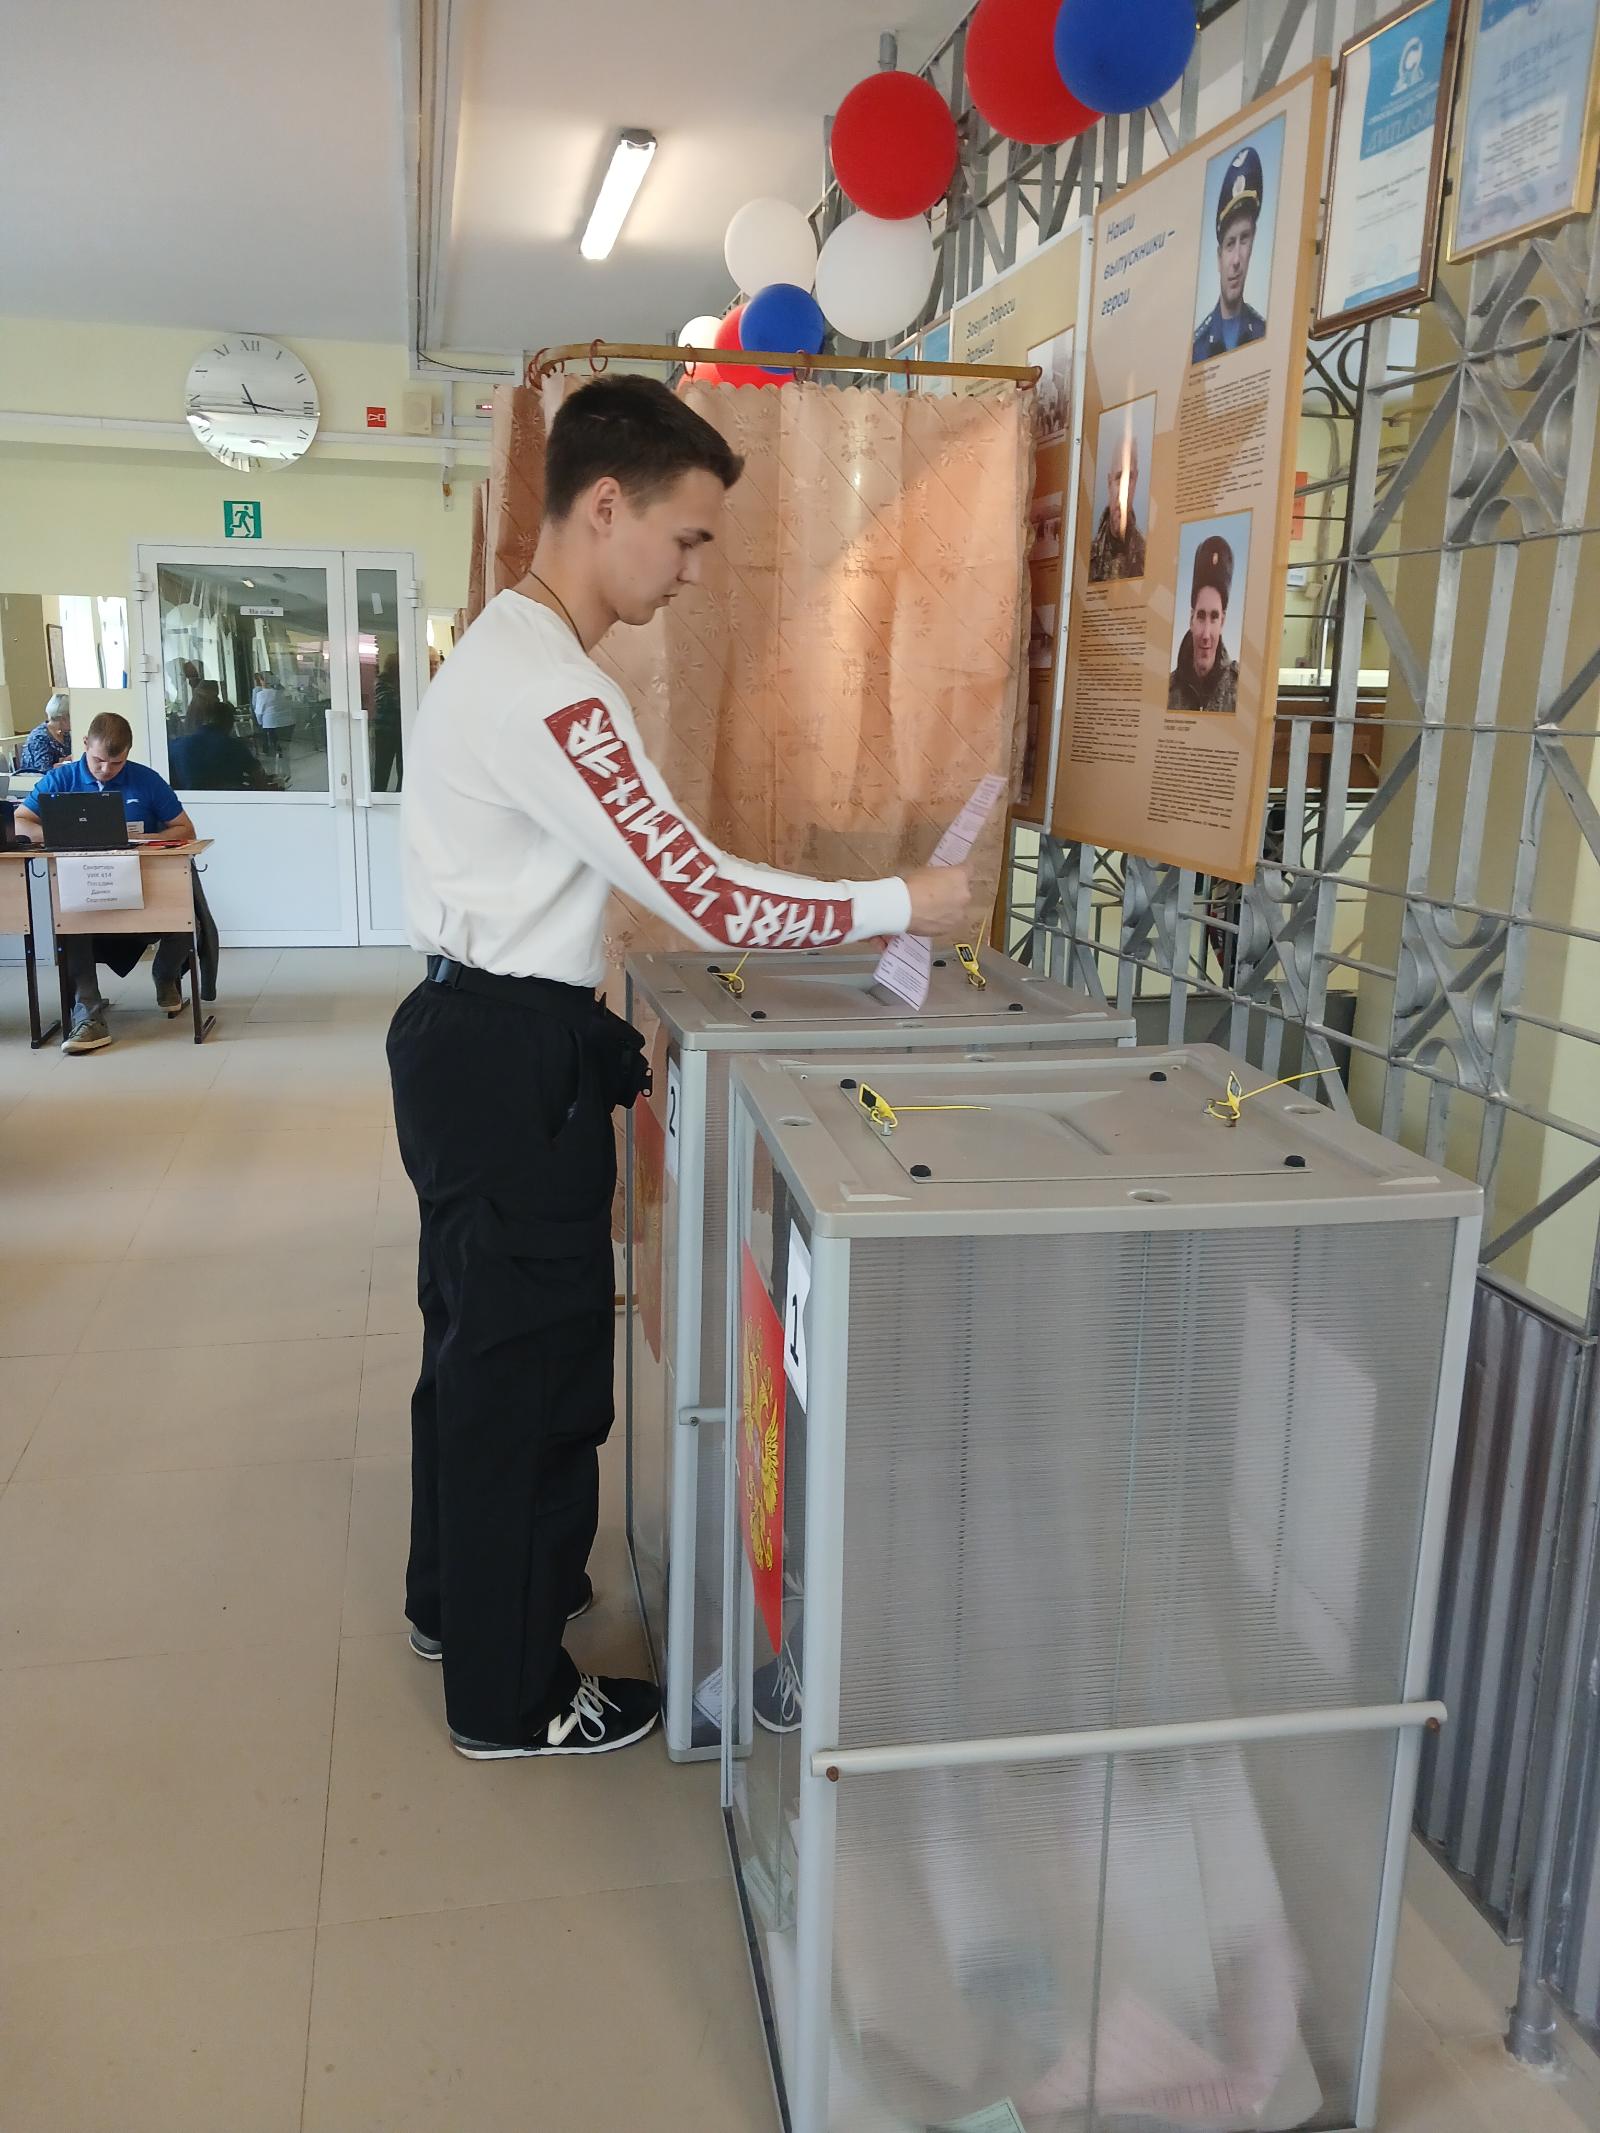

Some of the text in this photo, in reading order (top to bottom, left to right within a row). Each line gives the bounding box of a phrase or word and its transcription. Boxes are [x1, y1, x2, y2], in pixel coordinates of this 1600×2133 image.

[1106, 213, 1136, 244] Наши
[1103, 231, 1166, 280] выпускники
[989, 297, 1016, 326] дороги
[1101, 288, 1131, 316] герои
[790, 1293, 799, 1368] 1
